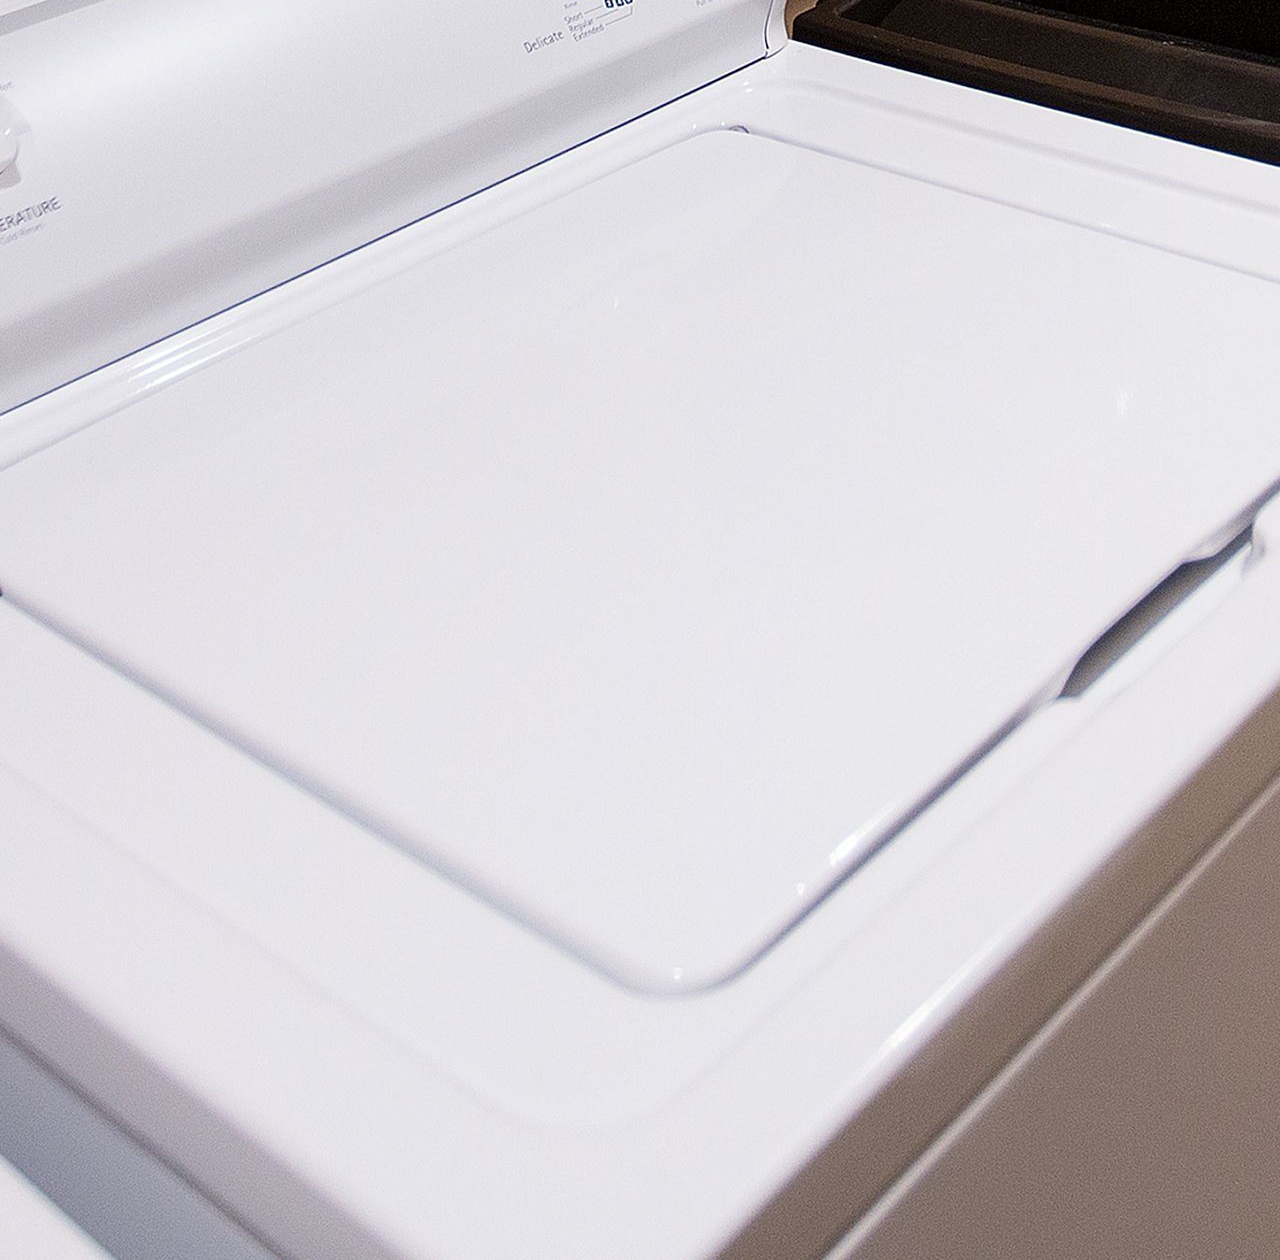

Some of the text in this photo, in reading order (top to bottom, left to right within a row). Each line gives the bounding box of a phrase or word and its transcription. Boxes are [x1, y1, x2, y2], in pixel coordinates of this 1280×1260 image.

[564, 11, 584, 25] Short
[568, 18, 594, 33] Regular
[572, 24, 605, 42] Extended
[523, 30, 565, 53] Delicate
